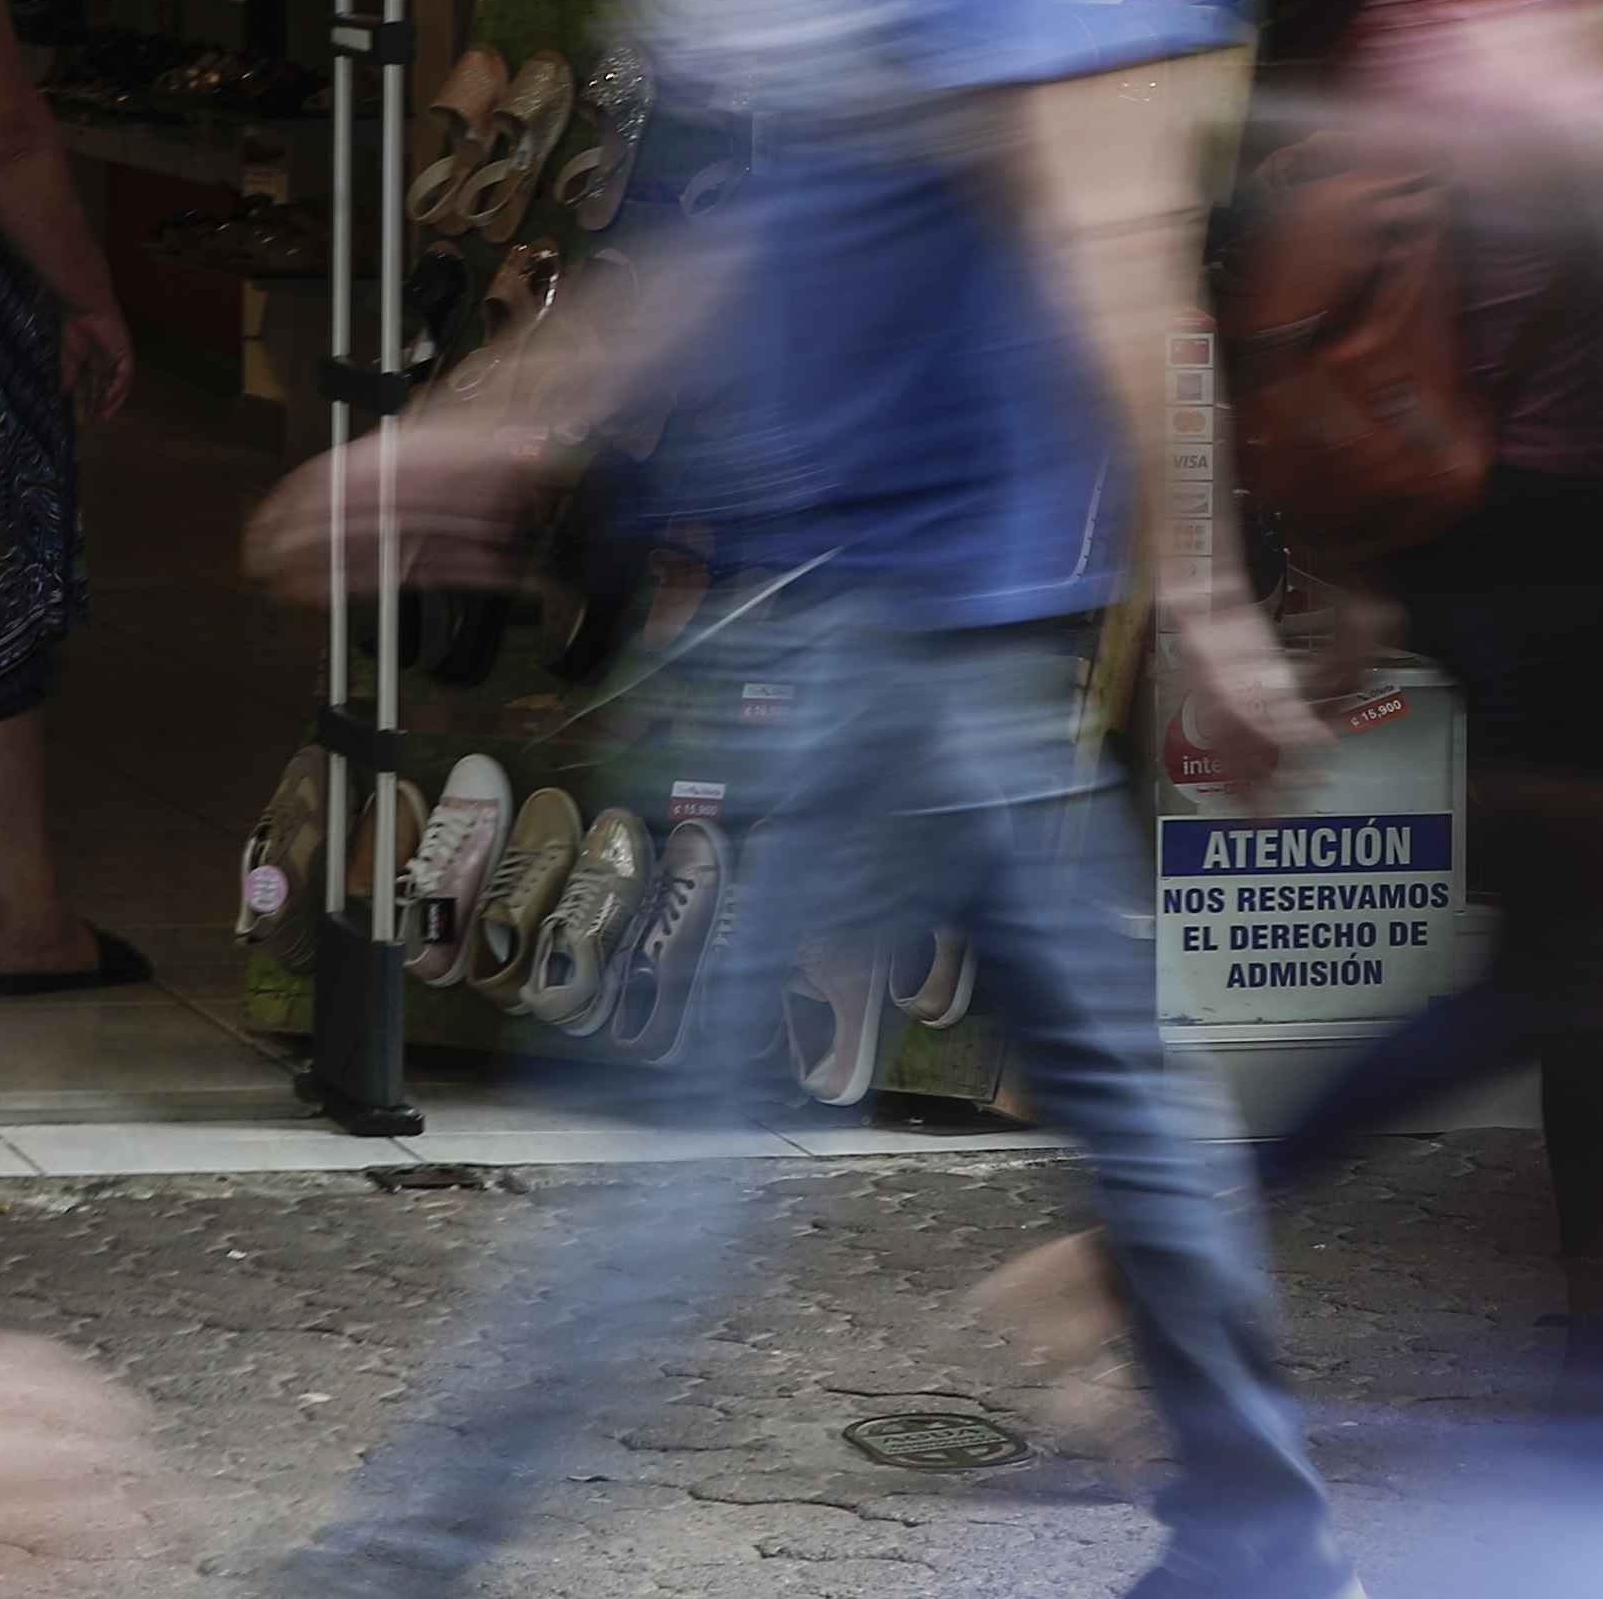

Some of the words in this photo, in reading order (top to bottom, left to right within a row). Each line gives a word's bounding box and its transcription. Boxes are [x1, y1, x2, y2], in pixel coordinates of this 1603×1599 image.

[1173, 455, 1209, 469] VISA
[1202, 817, 1413, 871] ATENCIÓN
[1162, 885, 1226, 915] NOS
[1236, 881, 1450, 913] RESERVAMOS
[1182, 925, 1220, 953] EL
[1228, 921, 1380, 952] DERECHO
[1388, 919, 1430, 948] DE
[1226, 952, 1384, 989] ADMISIÓN
